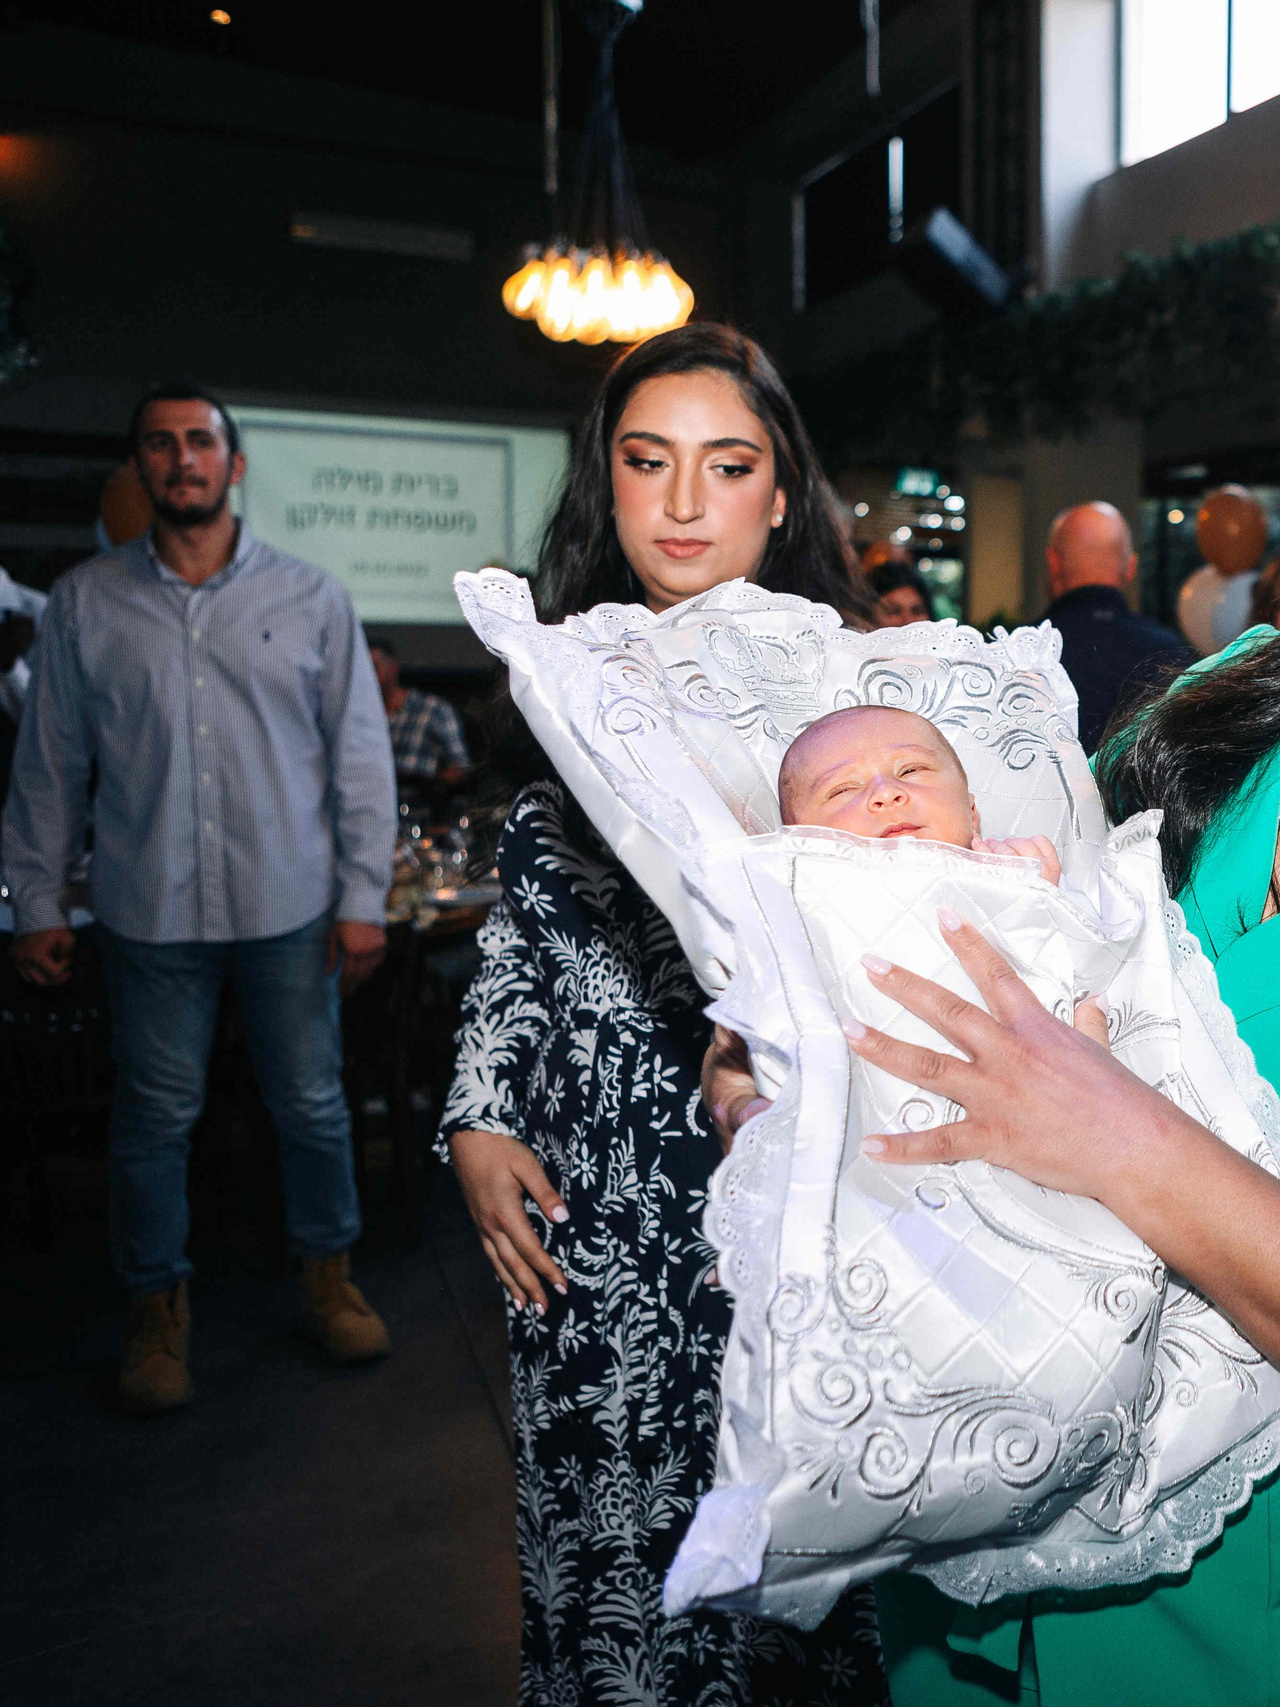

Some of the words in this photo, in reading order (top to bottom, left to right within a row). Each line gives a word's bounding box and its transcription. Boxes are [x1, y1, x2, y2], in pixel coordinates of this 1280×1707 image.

[311, 465, 383, 497] מילה
[391, 471, 460, 500] ברית
[367, 507, 478, 537] משפחת
